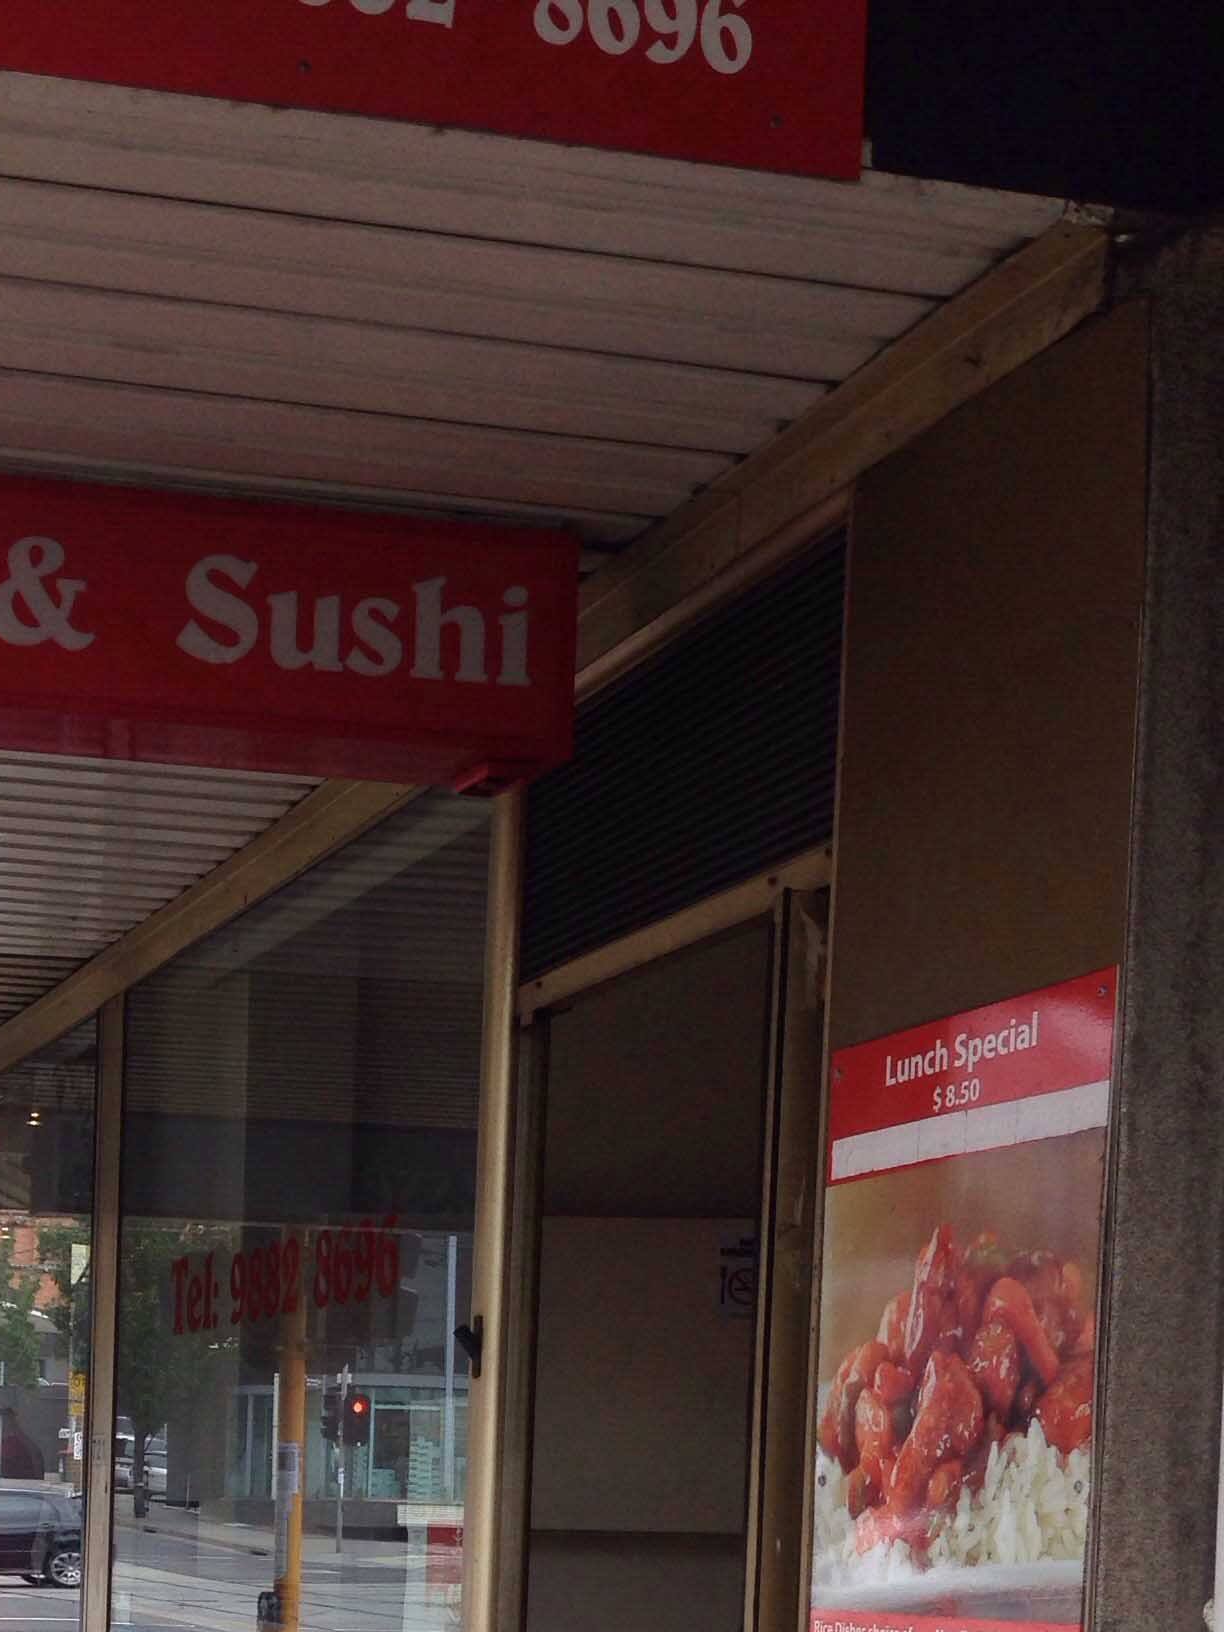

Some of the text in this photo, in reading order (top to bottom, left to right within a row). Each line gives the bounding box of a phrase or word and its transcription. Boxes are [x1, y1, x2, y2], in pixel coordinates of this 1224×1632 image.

[176, 554, 532, 688] Sushi
[886, 1011, 1040, 1087] Lunch Special
[171, 1252, 218, 1336] Tel:
